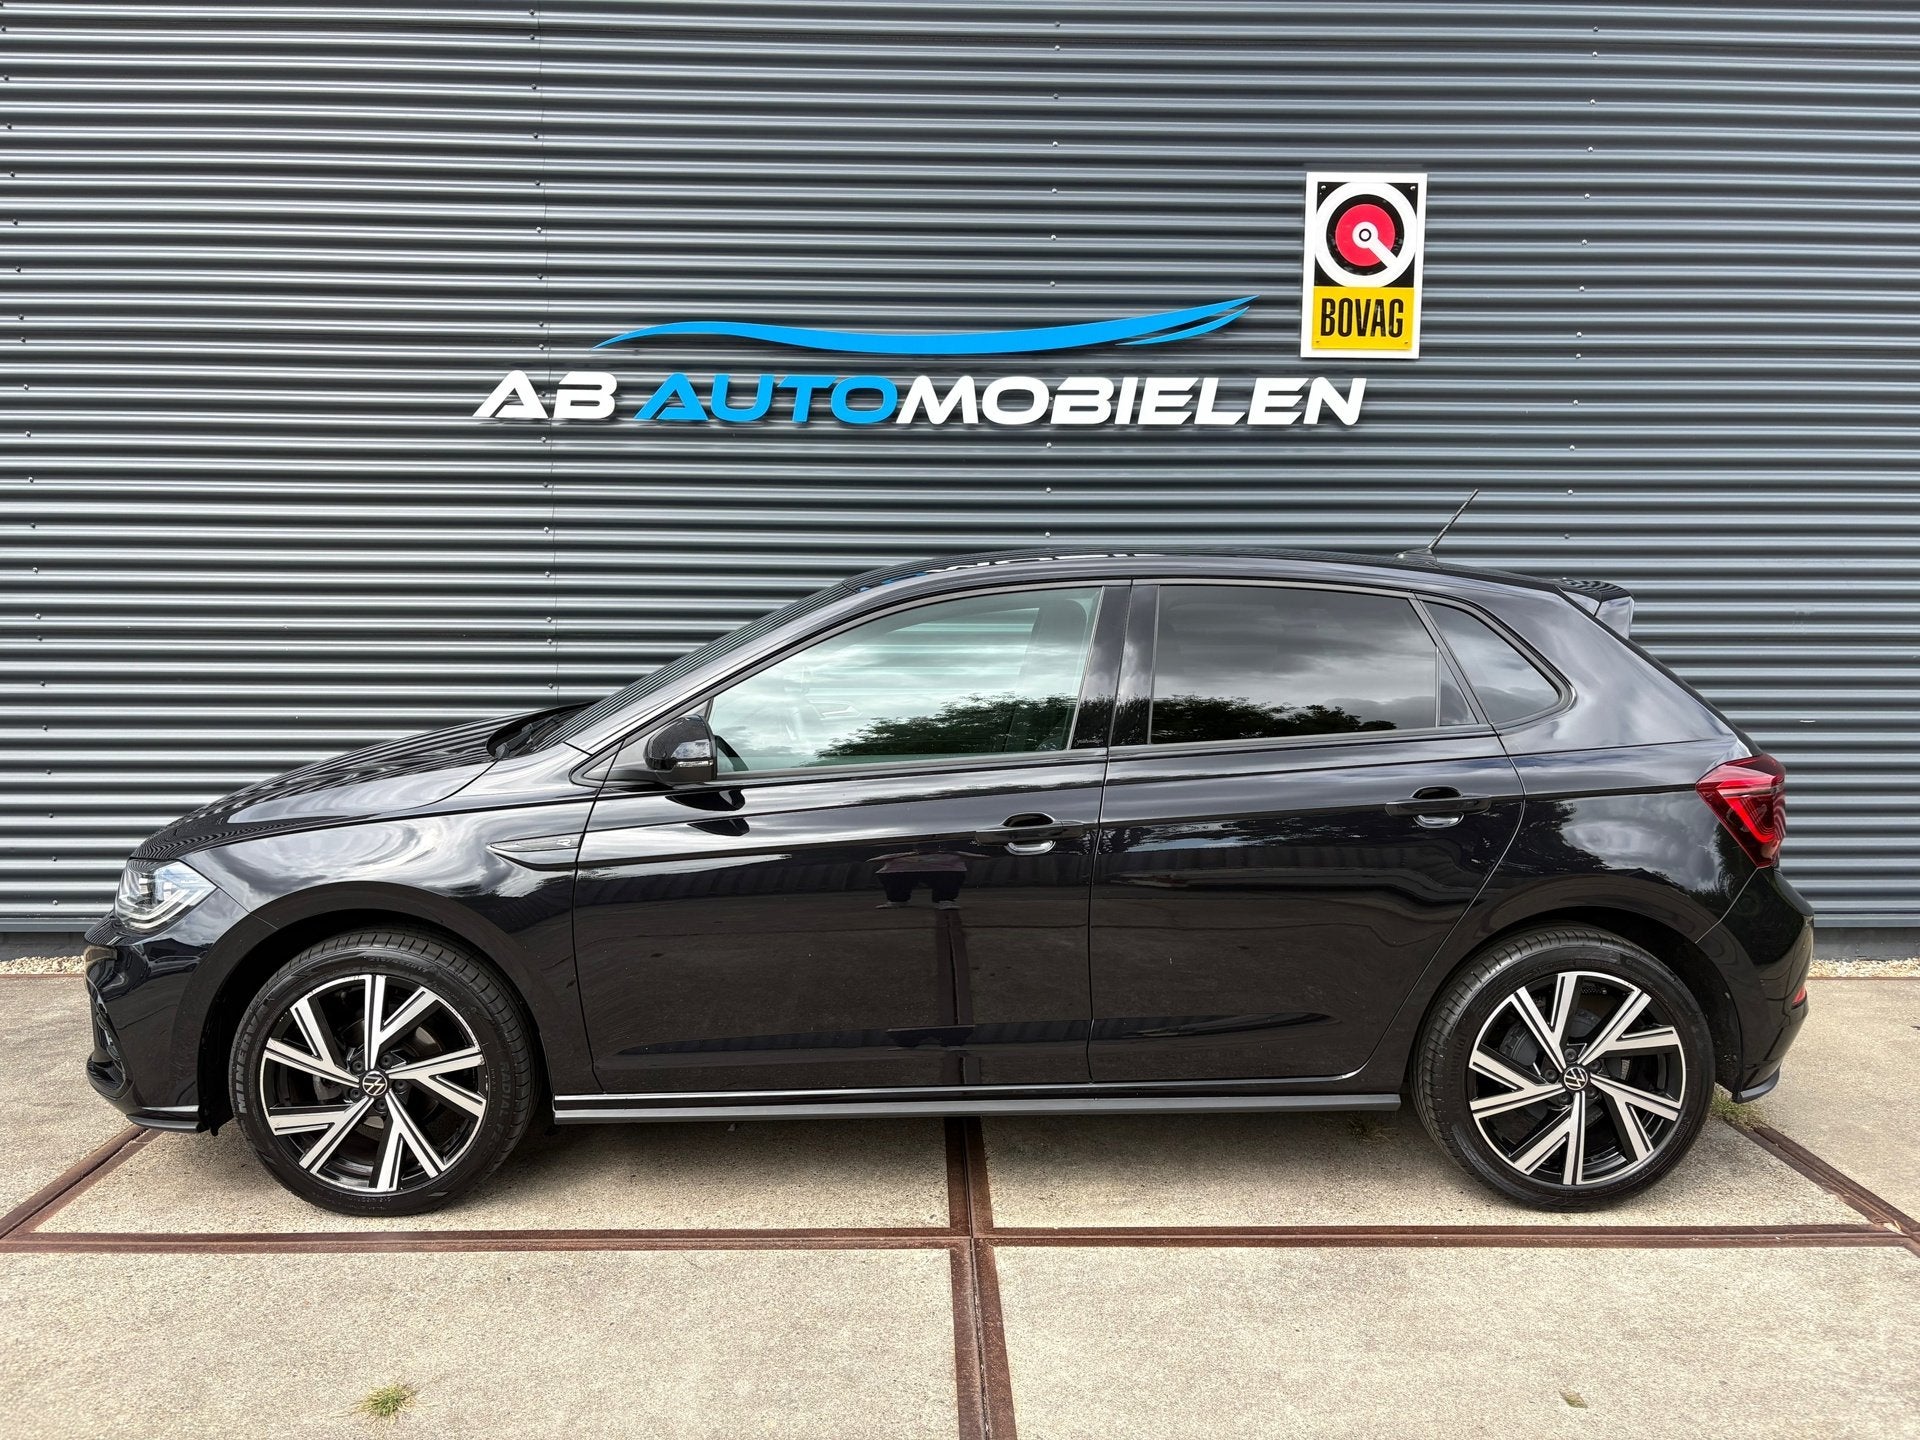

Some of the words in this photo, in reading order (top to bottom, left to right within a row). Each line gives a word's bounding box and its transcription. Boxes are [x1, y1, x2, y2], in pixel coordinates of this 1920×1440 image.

[1320, 297, 1404, 338] BOVAG
[472, 370, 618, 420] AB
[633, 372, 1368, 427] AUTOMOBIELEN
